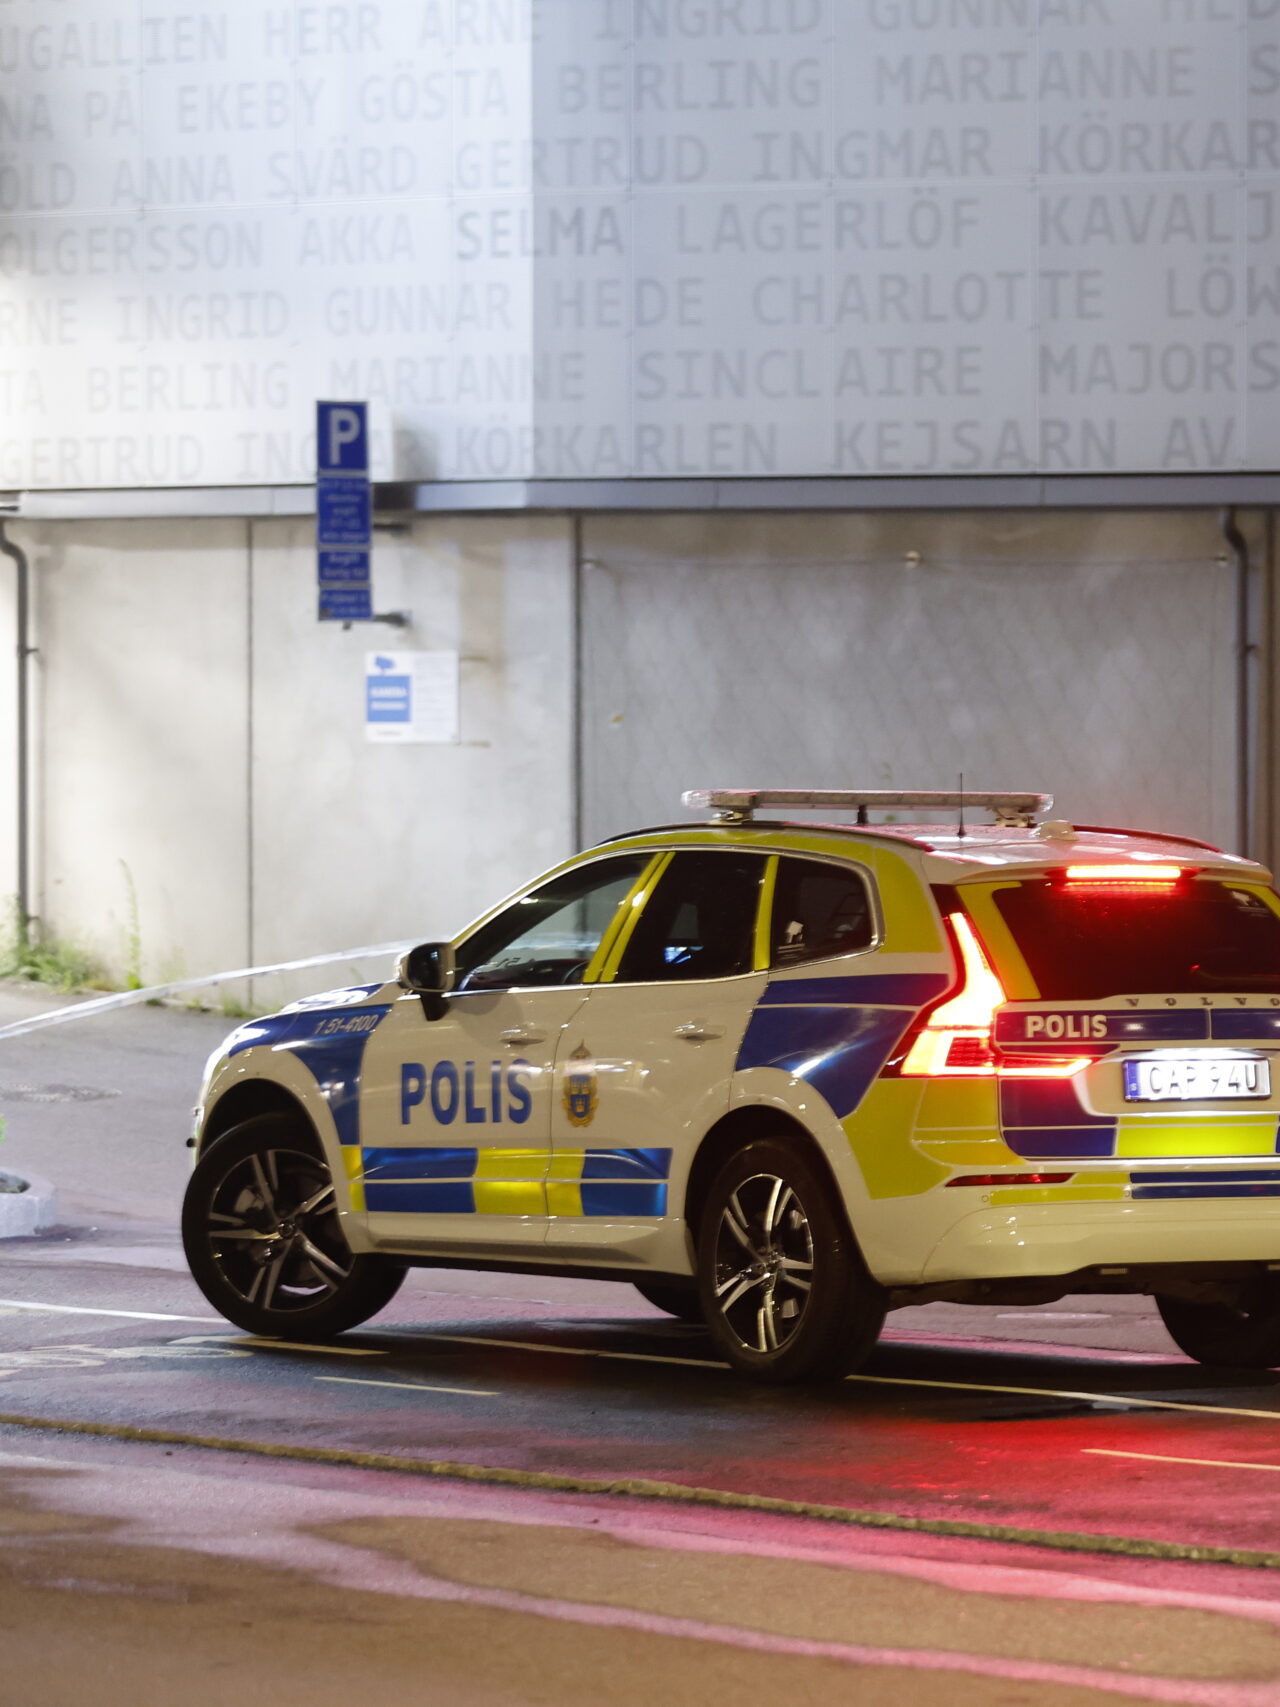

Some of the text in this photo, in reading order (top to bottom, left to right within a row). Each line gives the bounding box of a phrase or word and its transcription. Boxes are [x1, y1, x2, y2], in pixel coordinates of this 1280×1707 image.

[265, 5, 383, 58] HERR
[177, 77, 326, 133] EKEBY
[357, 60, 510, 123] GÖSTA
[557, 57, 822, 114] BERLING
[876, 46, 1195, 106] MARIANNE
[111, 154, 237, 206] ANNA
[266, 135, 419, 200] SVÄRD
[455, 134, 710, 191] GERTRUD
[751, 126, 995, 182] INGMAR
[300, 214, 416, 267] AKKA
[457, 206, 626, 261] SELMA
[677, 186, 981, 254] LAGERLÖF
[116, 291, 291, 343] INGRID
[324, 282, 513, 337] GUNNAR
[554, 278, 705, 329] HEDE
[752, 270, 1104, 327] CHARLOTTE
[87, 361, 290, 414] BERLING
[330, 352, 585, 406] MARIANNE
[636, 345, 982, 400] SINCLAIRE
[328, 409, 361, 465] P
[456, 417, 777, 477] KÖRKARLEN
[833, 418, 1118, 473] KEJSARN
[1162, 416, 1236, 470] AV
[1026, 1014, 1108, 1039] POLIS
[1126, 996, 1280, 1008] VOLVO
[401, 1058, 533, 1126] POLIS
